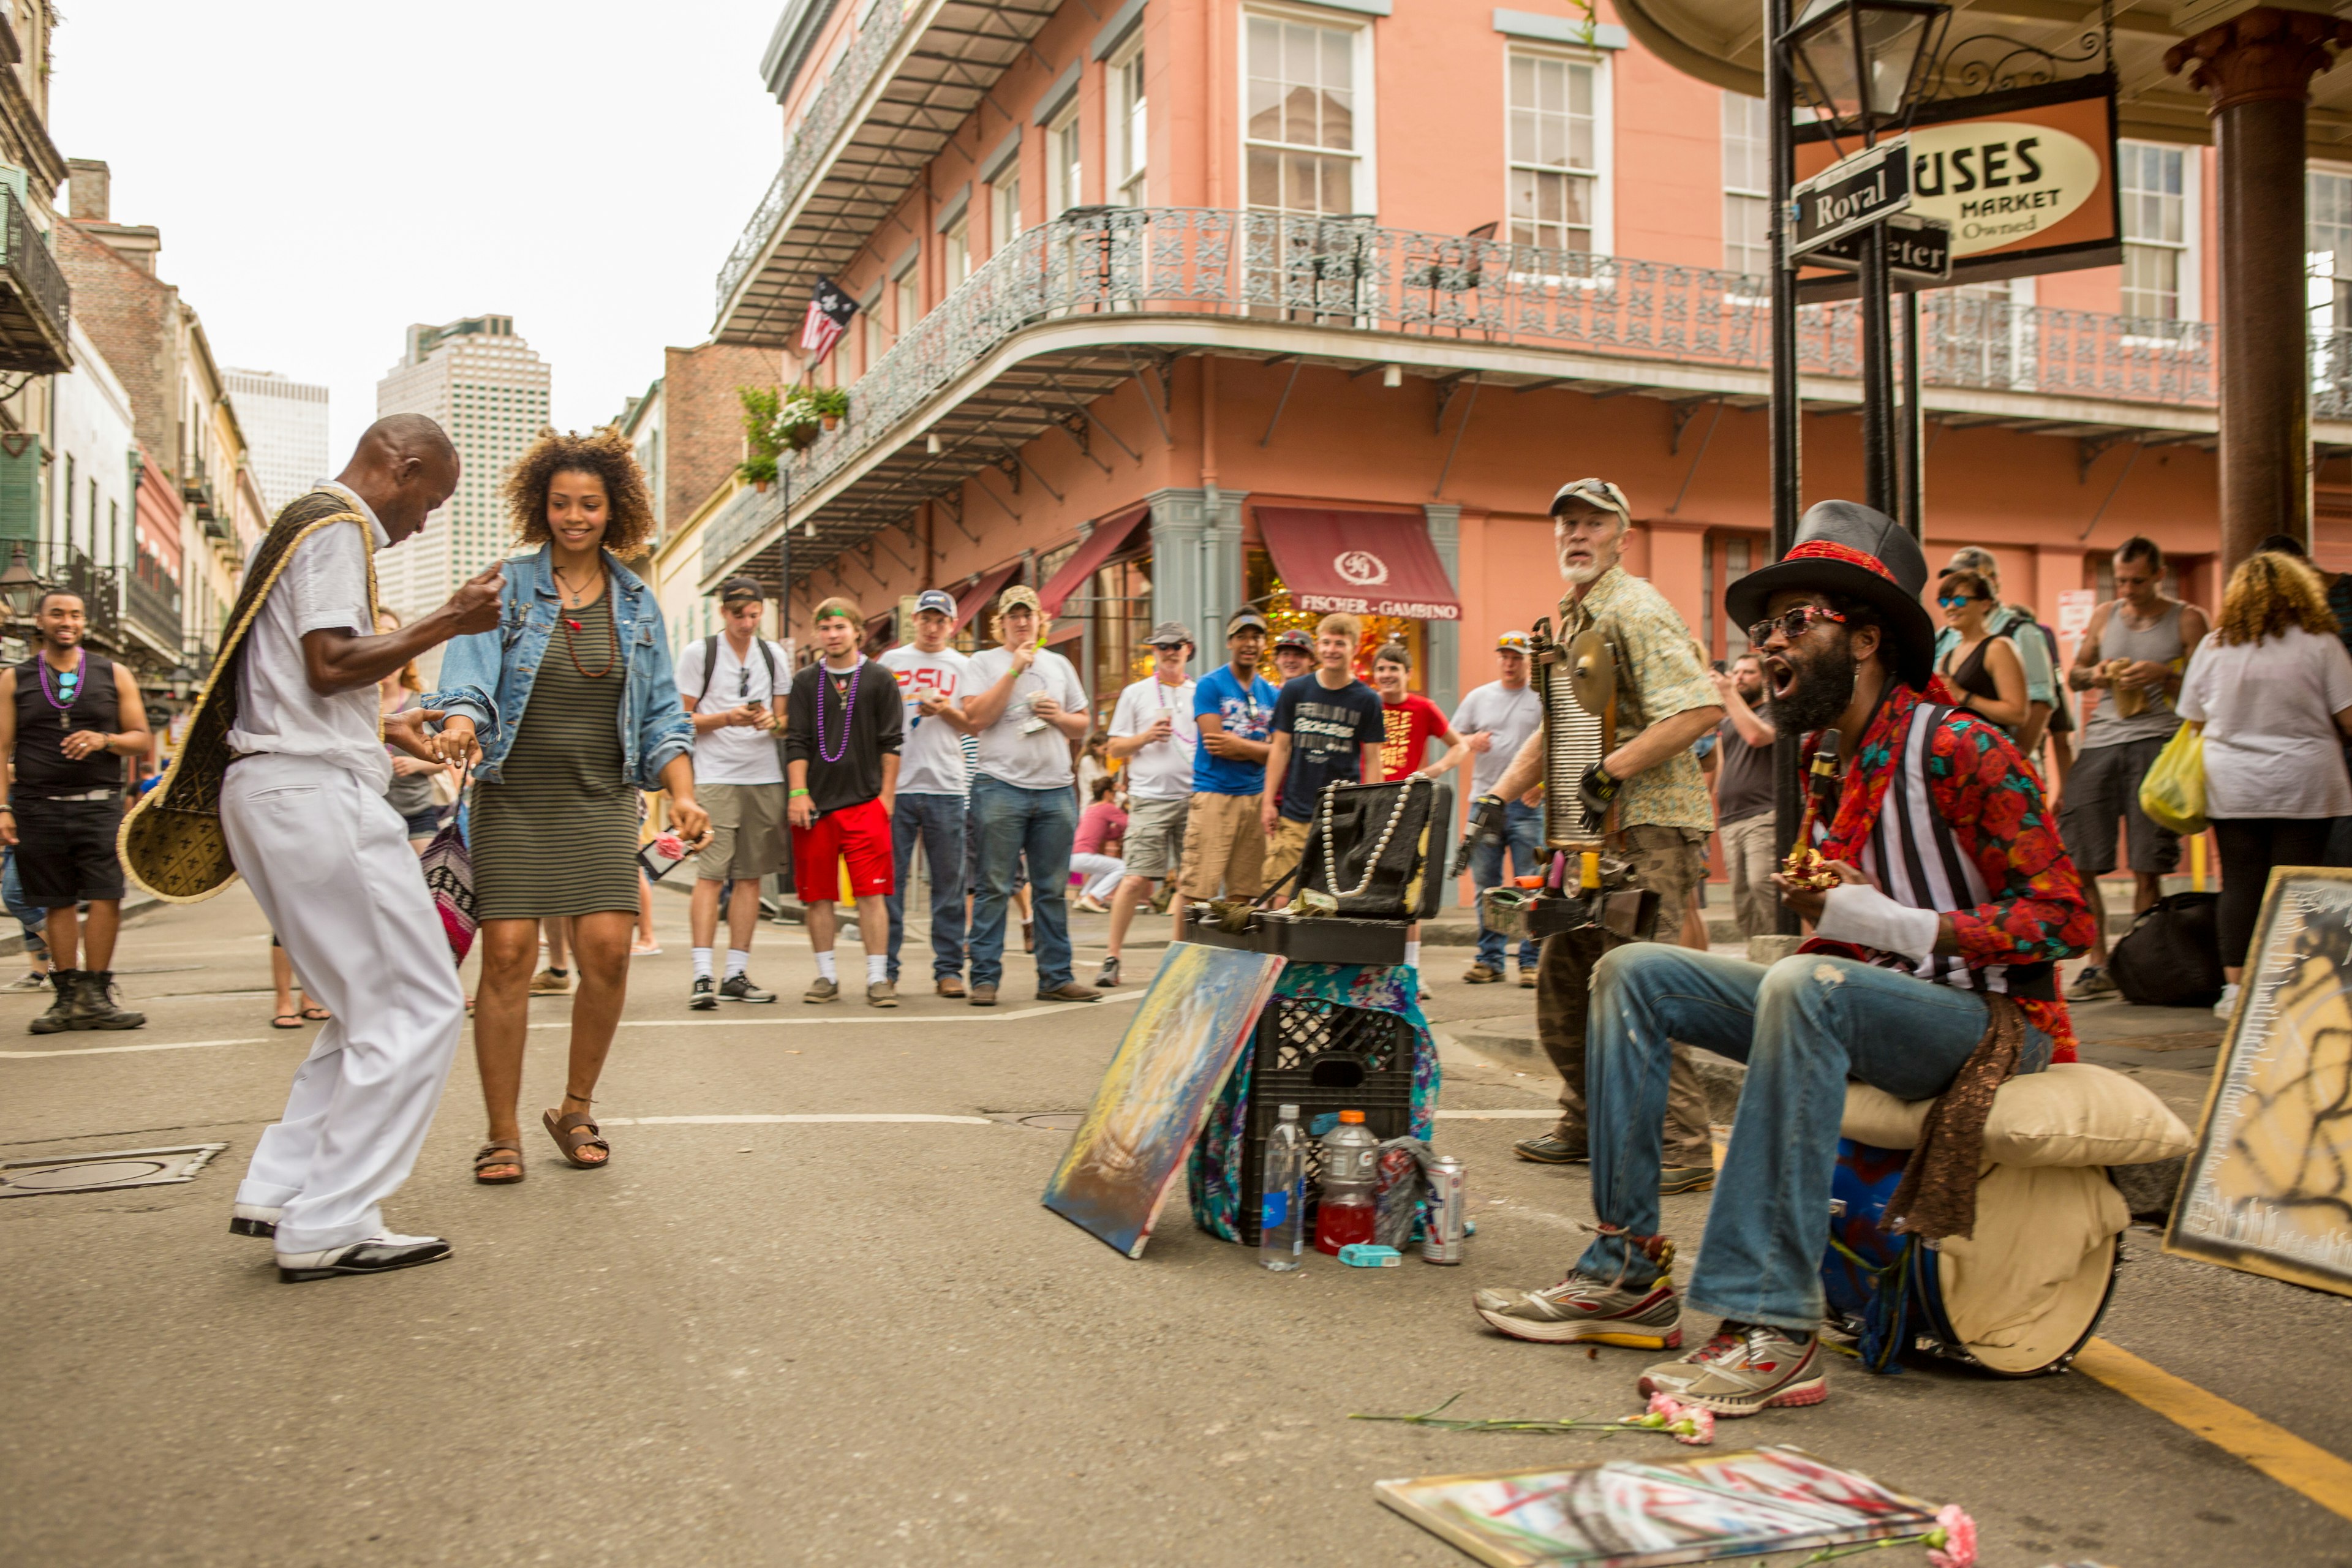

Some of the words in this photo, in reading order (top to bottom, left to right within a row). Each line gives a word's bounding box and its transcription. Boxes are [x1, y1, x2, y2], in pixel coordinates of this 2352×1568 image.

[1914, 137, 2042, 198] USES
[1815, 168, 1887, 229] Royal
[1961, 189, 2062, 219] MARKET
[1962, 214, 2037, 239] Owned
[1887, 240, 1946, 268] eter
